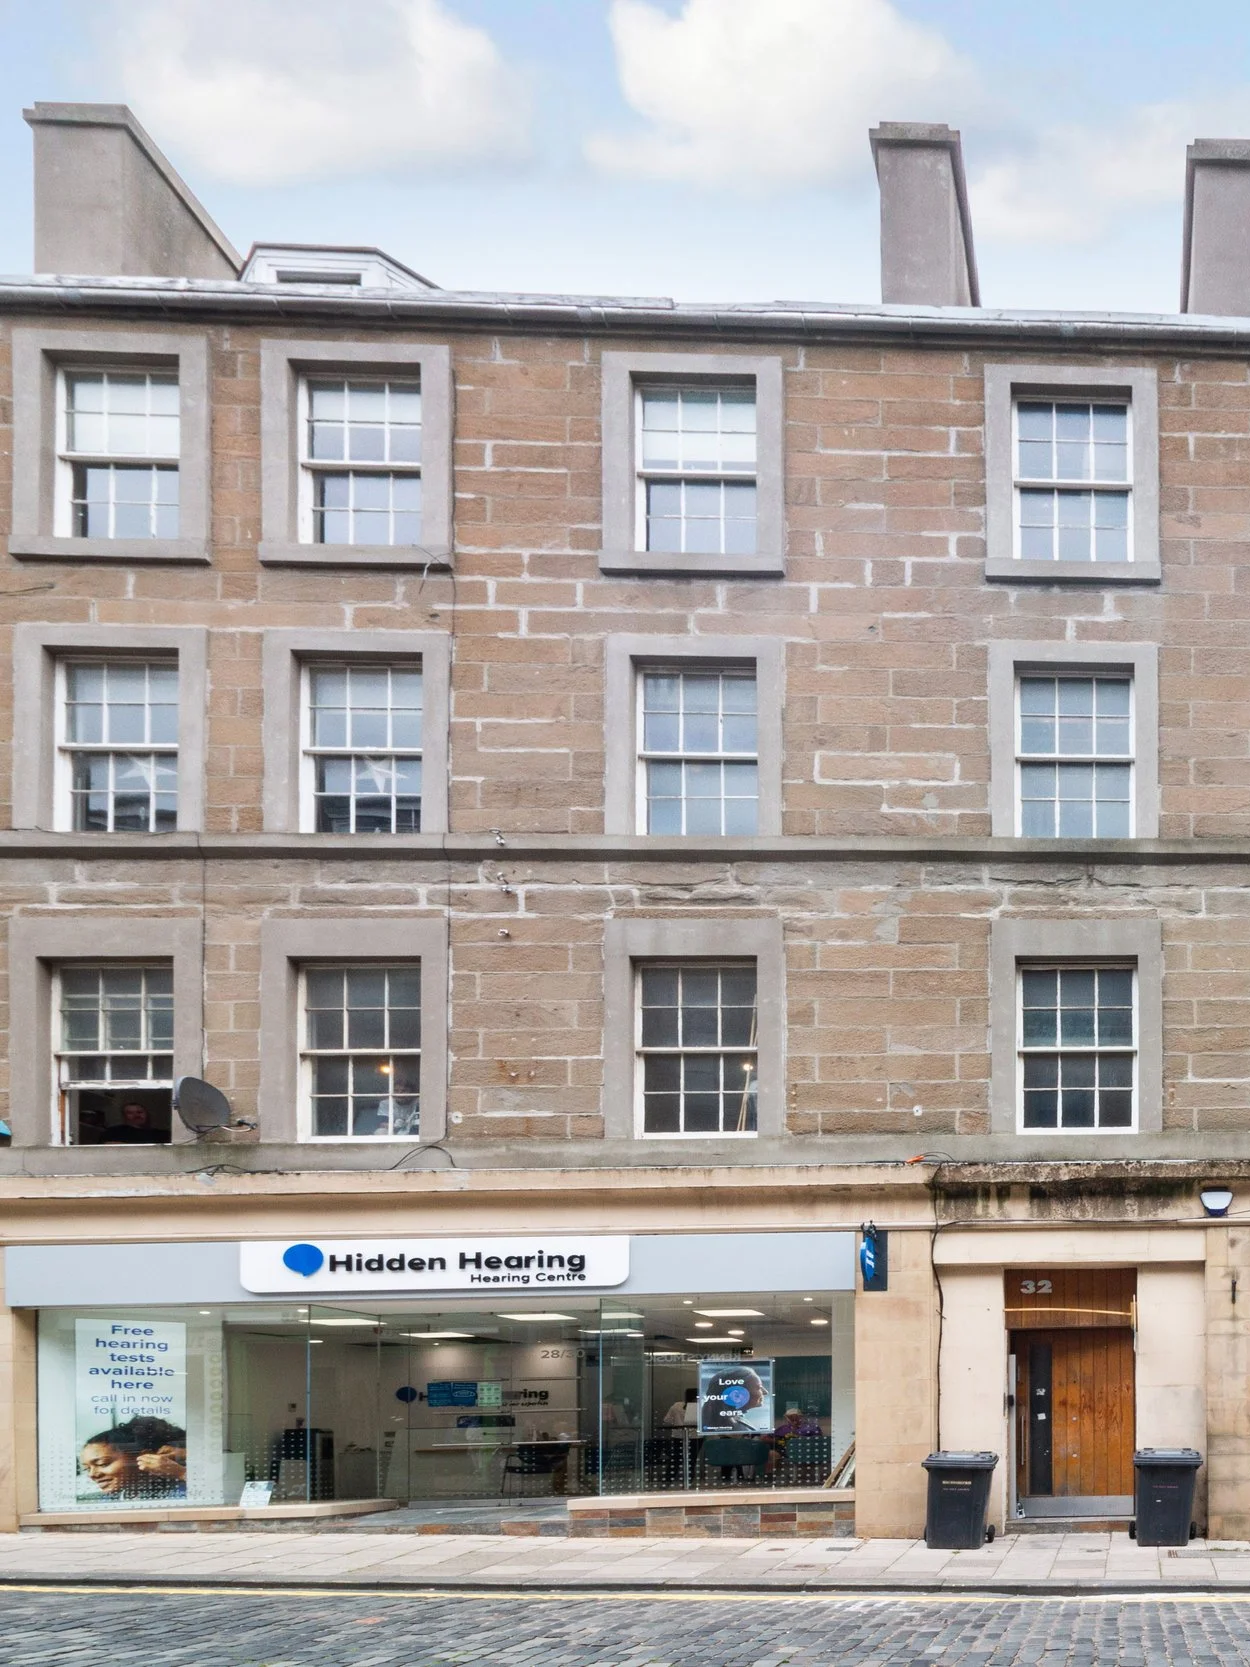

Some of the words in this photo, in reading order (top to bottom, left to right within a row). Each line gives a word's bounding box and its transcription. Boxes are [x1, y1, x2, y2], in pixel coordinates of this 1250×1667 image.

[328, 1252, 447, 1273] Hidden
[458, 1250, 586, 1273] Hearing
[470, 1272, 530, 1284] Hearing
[535, 1271, 587, 1283] Centre
[1020, 1280, 1052, 1295] 32
[111, 1324, 154, 1336] Free
[95, 1338, 168, 1352] hearing
[109, 1352, 155, 1363] tests
[89, 1365, 175, 1377] available
[111, 1379, 154, 1389] here
[718, 1378, 745, 1386] Love
[91, 1394, 117, 1403] call
[123, 1394, 136, 1402] in
[141, 1395, 173, 1403] now
[703, 1394, 728, 1403] your
[94, 1405, 116, 1414] for
[120, 1406, 171, 1415] details
